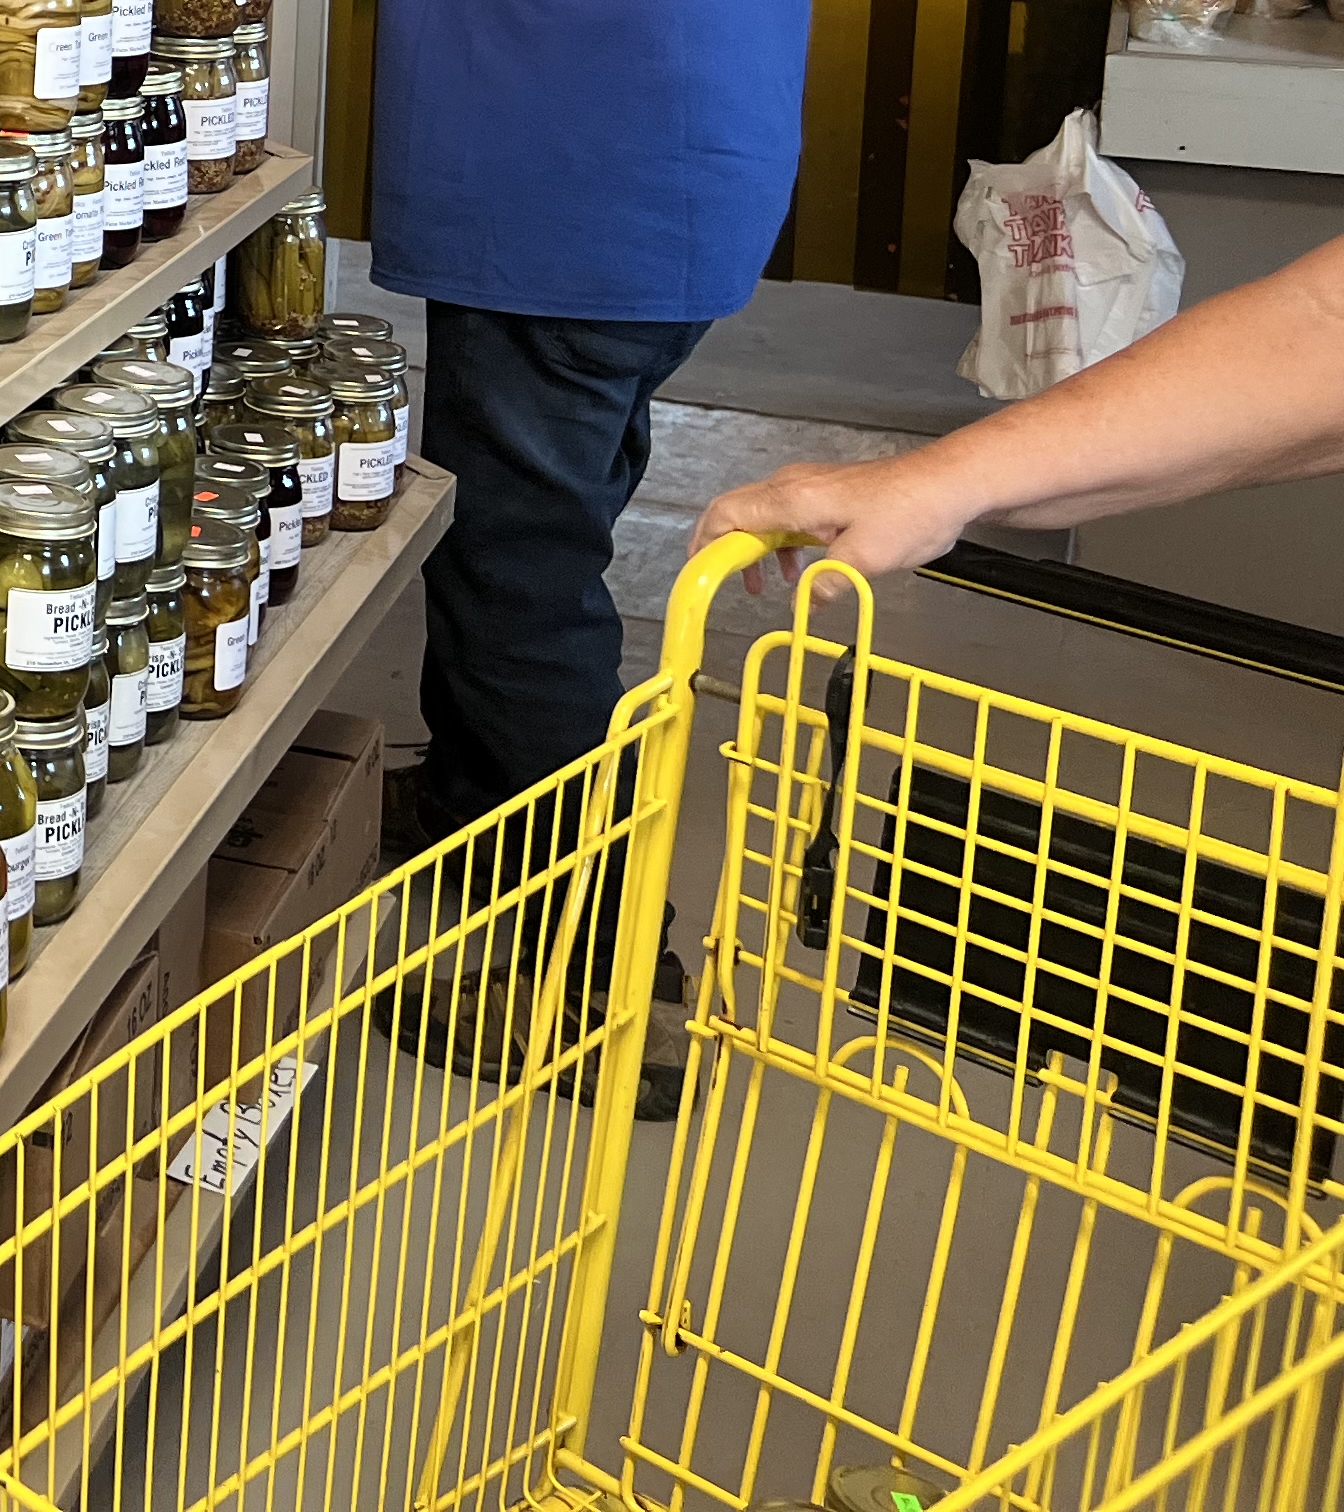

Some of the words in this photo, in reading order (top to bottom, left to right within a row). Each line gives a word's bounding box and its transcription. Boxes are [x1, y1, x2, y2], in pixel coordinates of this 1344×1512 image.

[38, 231, 62, 244] Green
[45, 602, 76, 617] Bread
[36, 812, 66, 827] Bread
